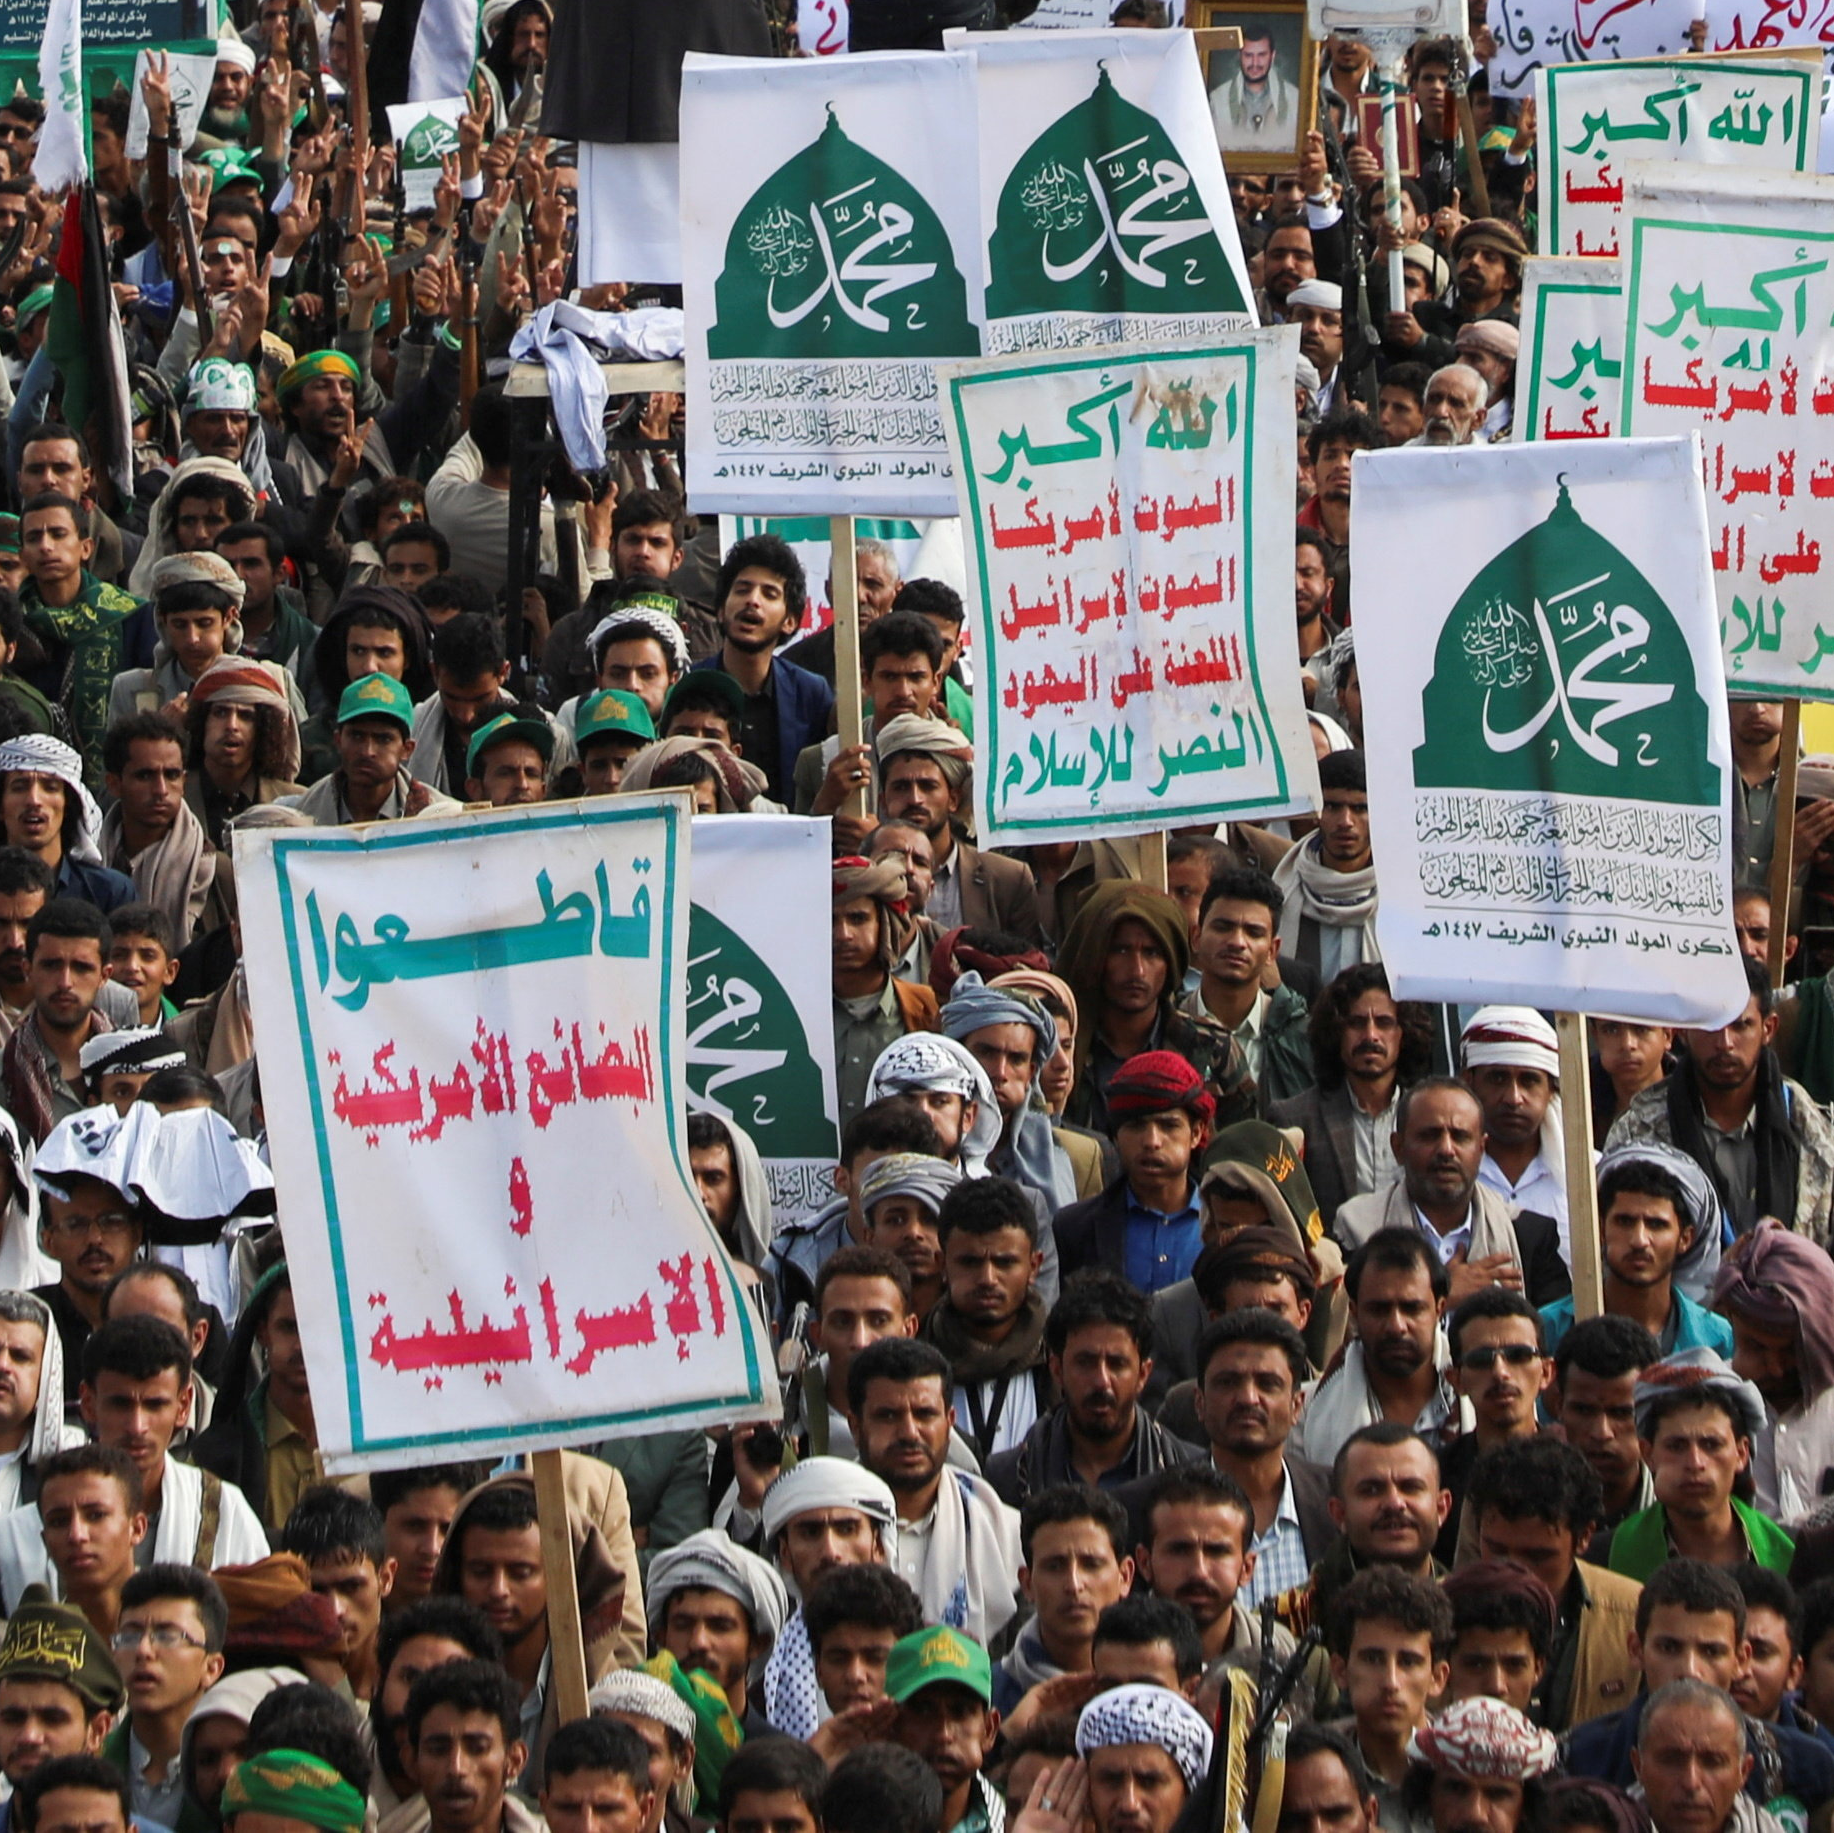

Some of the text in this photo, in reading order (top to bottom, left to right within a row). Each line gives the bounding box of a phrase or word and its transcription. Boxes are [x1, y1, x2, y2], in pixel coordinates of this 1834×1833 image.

[983, 376, 1132, 491] أكبر
[990, 478, 1234, 554] الموت لأمريكا
[1001, 558, 1235, 640] الموت لإسرائيل
[1004, 632, 1242, 718] اللعنة على اليهود
[1479, 572, 1675, 766] محمد
[1002, 705, 1263, 812] النصر للإسلام
[306, 859, 651, 1012] قاطعوا
[1423, 921, 1733, 956] ذكرى المولد النبوي الشريف ١٤٤٧هـ
[328, 1018, 654, 1145] البضائع الأمريكية
[505, 1157, 534, 1236] و
[369, 1253, 725, 1388] الإسرائيلية
